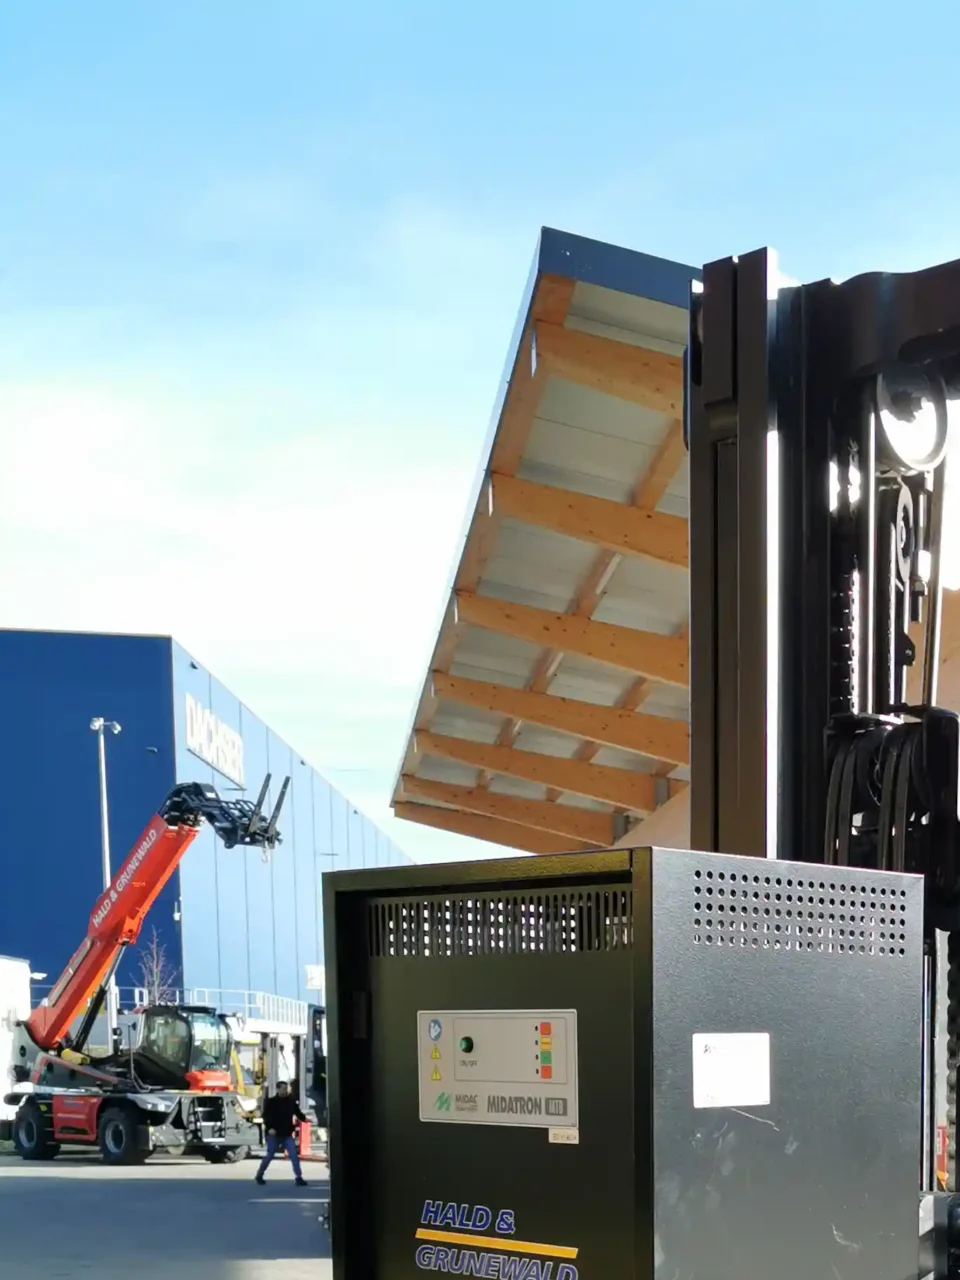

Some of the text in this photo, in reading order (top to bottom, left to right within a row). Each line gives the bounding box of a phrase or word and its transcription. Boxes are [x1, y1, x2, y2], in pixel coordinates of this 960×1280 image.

[186, 691, 243, 785] DACHSER
[93, 829, 157, 928] HALD & GRUNEWALD
[487, 1095, 542, 1115] MIDATRON
[421, 1200, 516, 1234] HALD &
